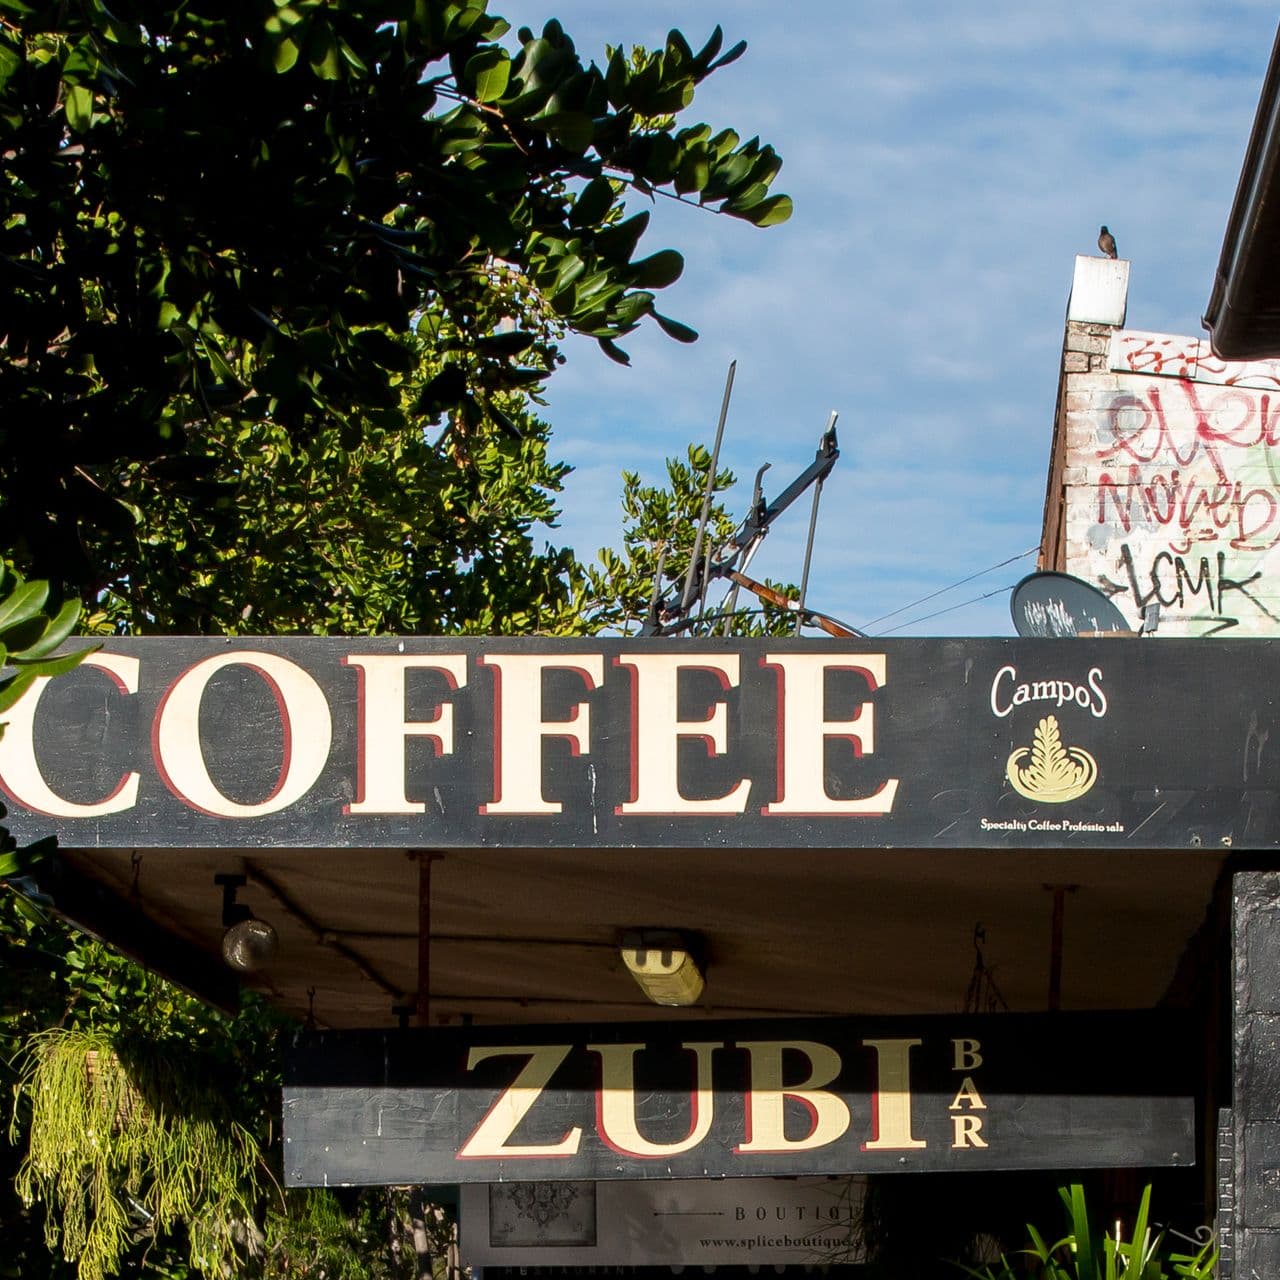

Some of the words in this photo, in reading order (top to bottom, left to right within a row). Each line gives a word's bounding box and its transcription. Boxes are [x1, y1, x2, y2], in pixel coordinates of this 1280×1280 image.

[980, 818, 1027, 832] Specialty
[1028, 820, 1061, 832] Coffee
[456, 1038, 927, 1160] ZUBI
[948, 1038, 989, 1149] BAR
